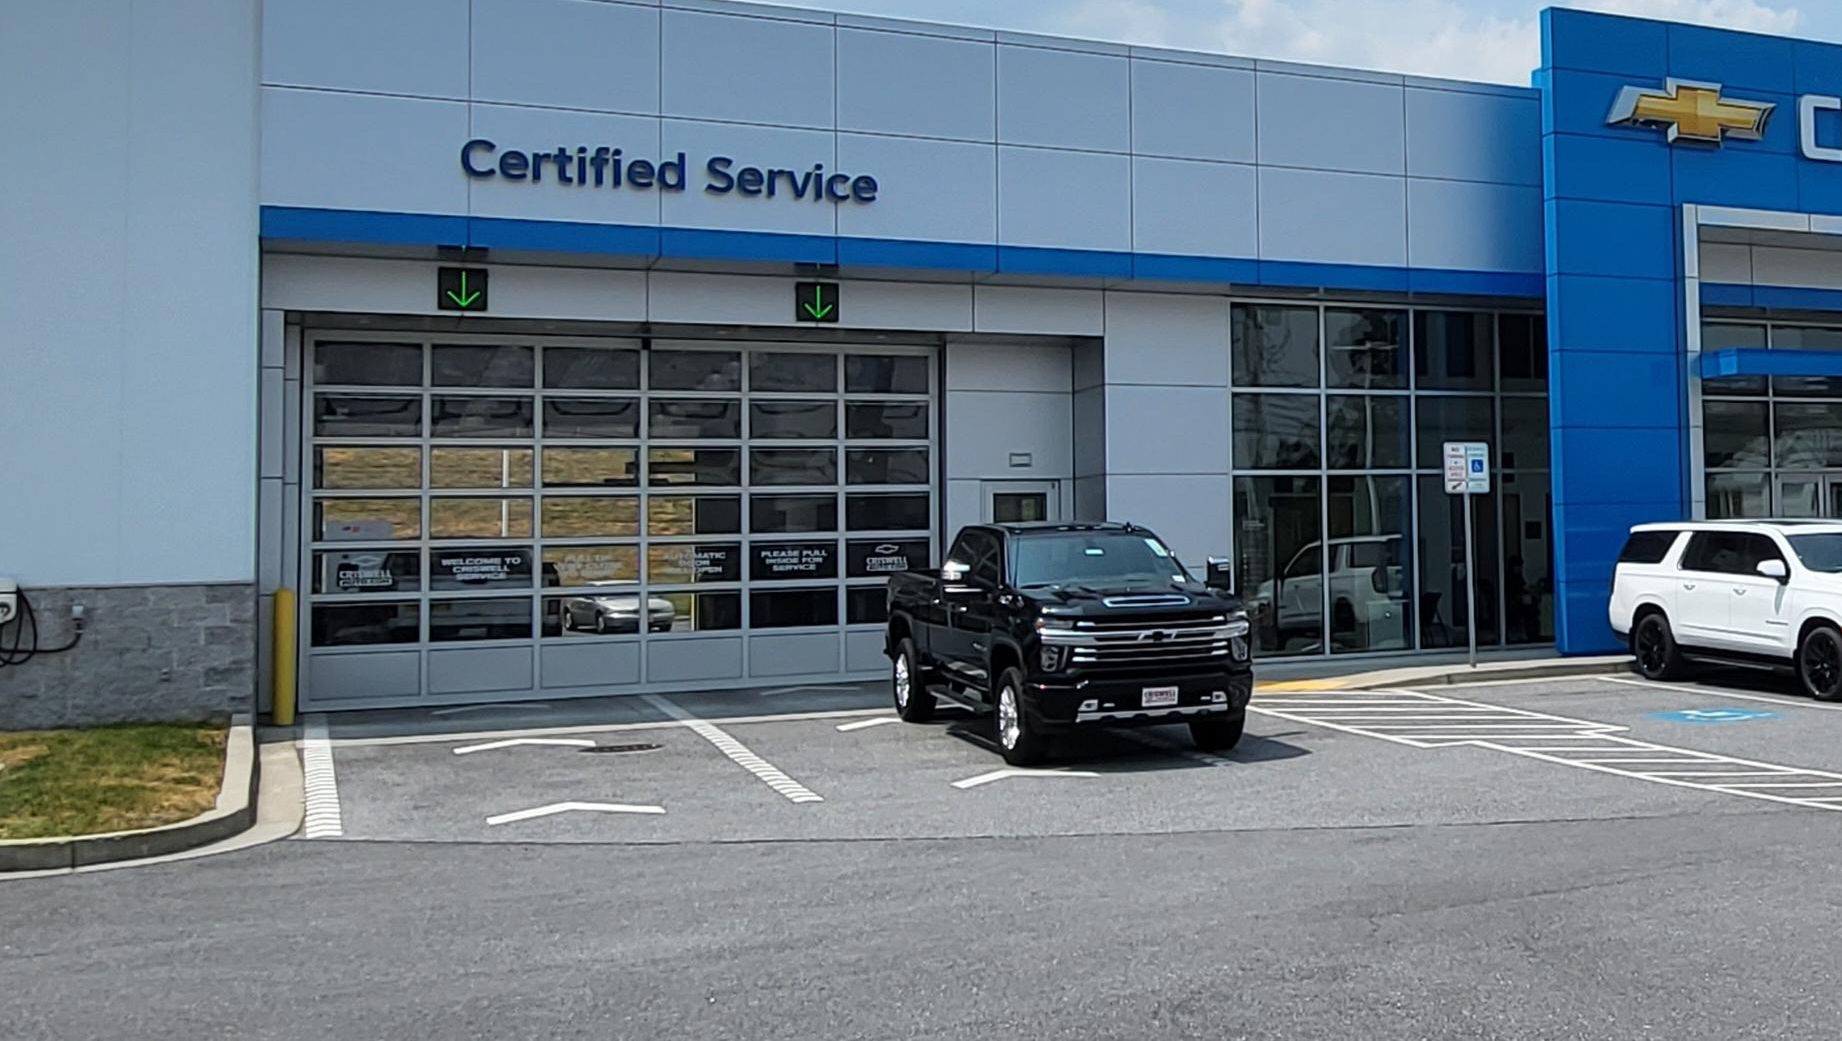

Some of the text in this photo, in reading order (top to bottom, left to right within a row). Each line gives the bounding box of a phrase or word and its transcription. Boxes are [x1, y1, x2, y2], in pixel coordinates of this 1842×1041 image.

[460, 139, 879, 203] Certified Service
[761, 549, 827, 558] PLEASE PULL
[441, 557, 521, 566] WELCOME TO
[339, 569, 392, 578] CRISWELL
[452, 565, 510, 573] CRISWELL
[456, 572, 507, 580] SERVICE
